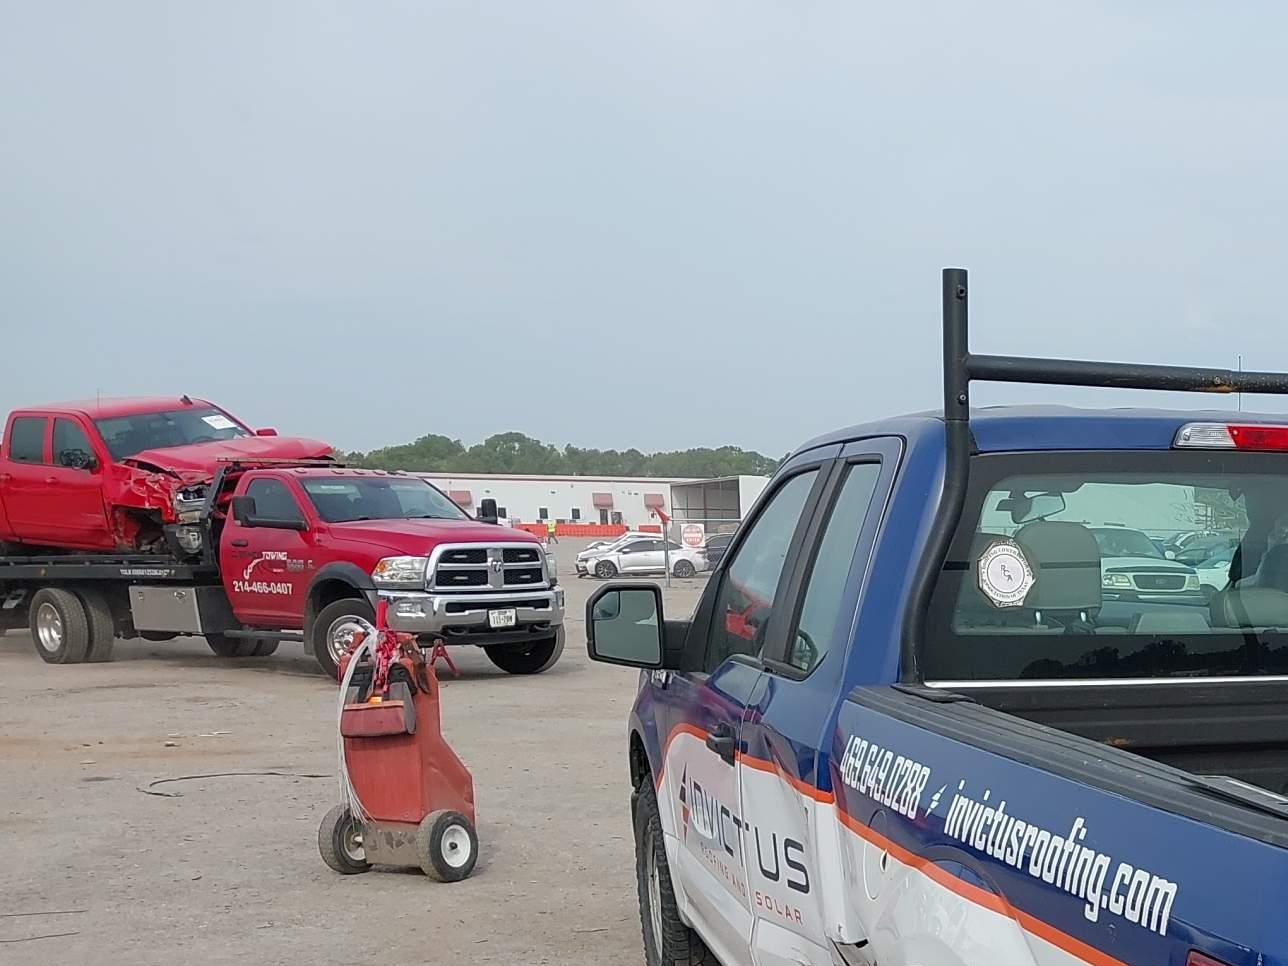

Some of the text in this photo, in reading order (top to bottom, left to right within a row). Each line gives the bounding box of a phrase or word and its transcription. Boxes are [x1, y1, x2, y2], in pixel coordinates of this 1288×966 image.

[232, 580, 293, 596] 214-466-0407
[262, 551, 288, 561] TOWING
[839, 734, 932, 820] 469.649.0288
[689, 776, 810, 894] INVICTUS
[943, 779, 1178, 936] invictusroofing.com
[731, 875, 746, 898] AND
[755, 891, 803, 925] SOLAR
